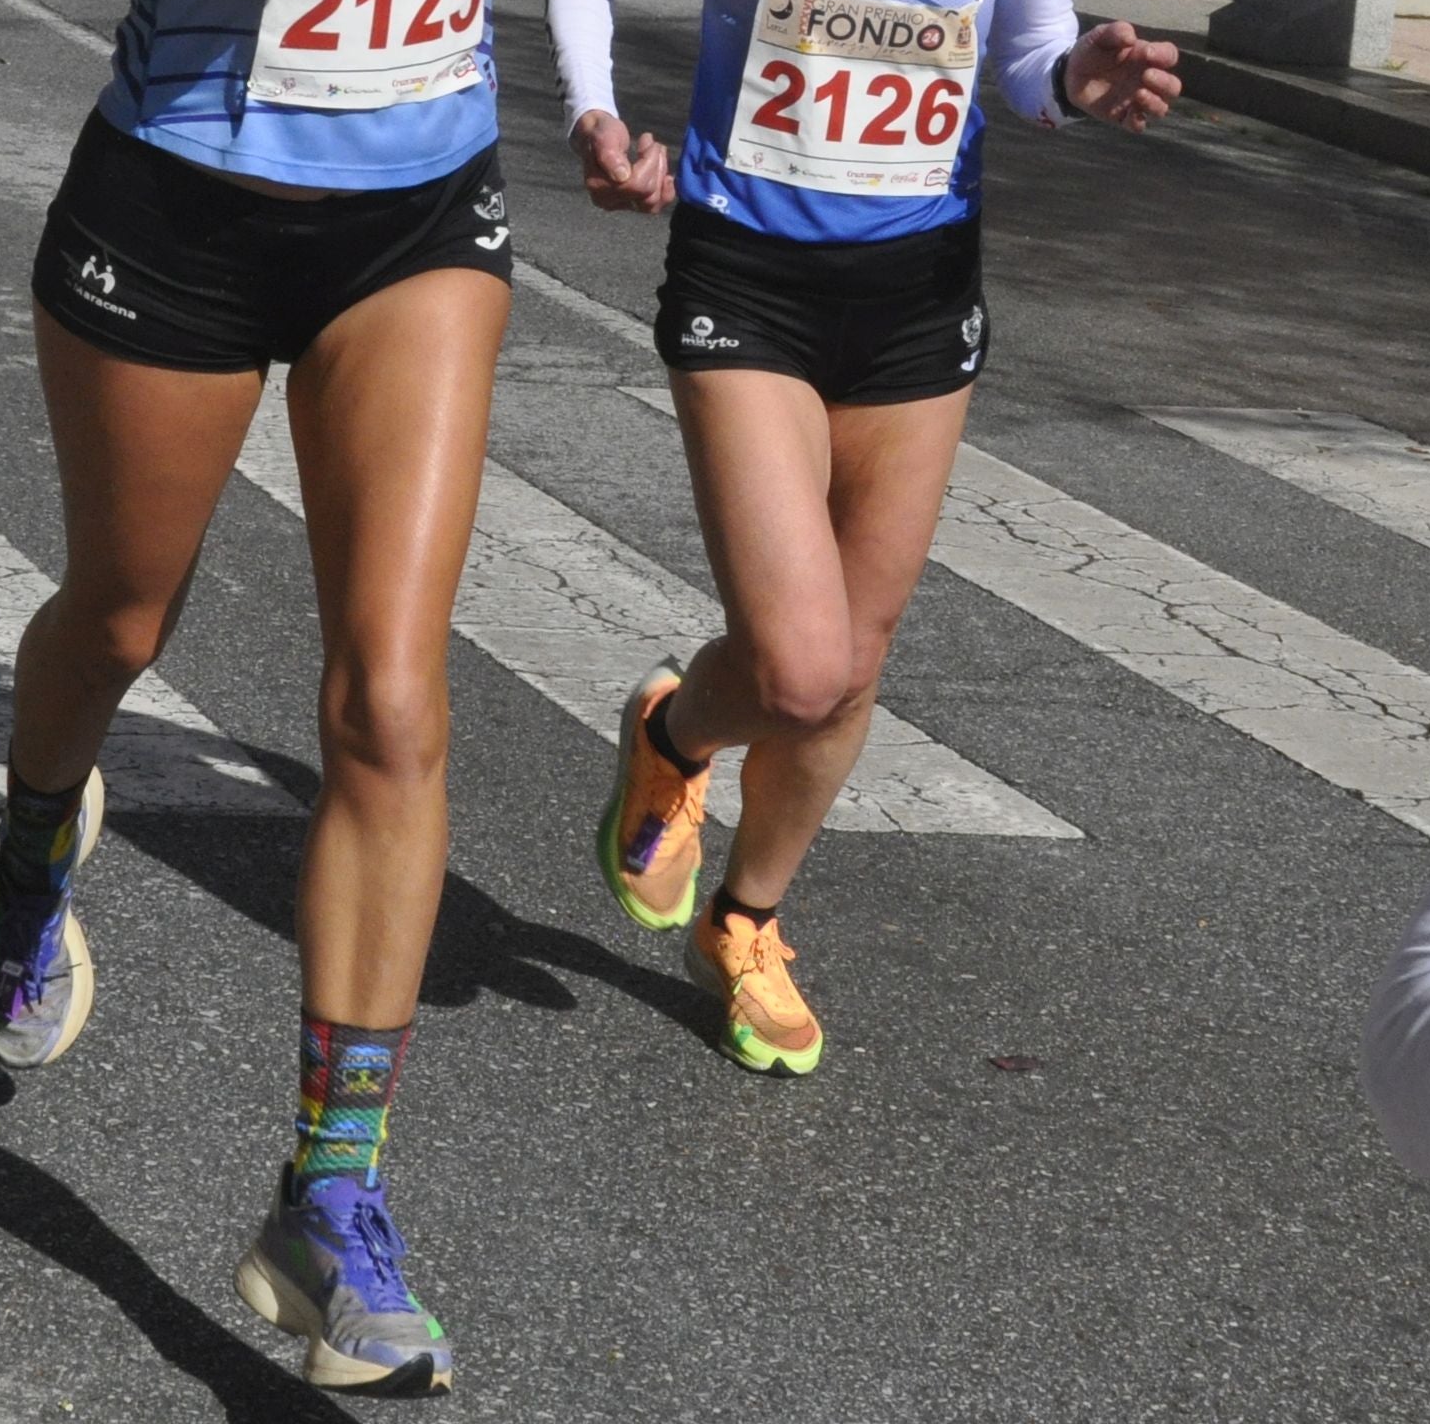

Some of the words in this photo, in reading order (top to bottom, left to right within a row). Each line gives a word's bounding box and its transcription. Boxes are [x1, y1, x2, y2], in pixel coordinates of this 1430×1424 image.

[807, 9, 946, 52] FONDO
[864, 5, 924, 26] PREMIO
[750, 59, 966, 146] 2126
